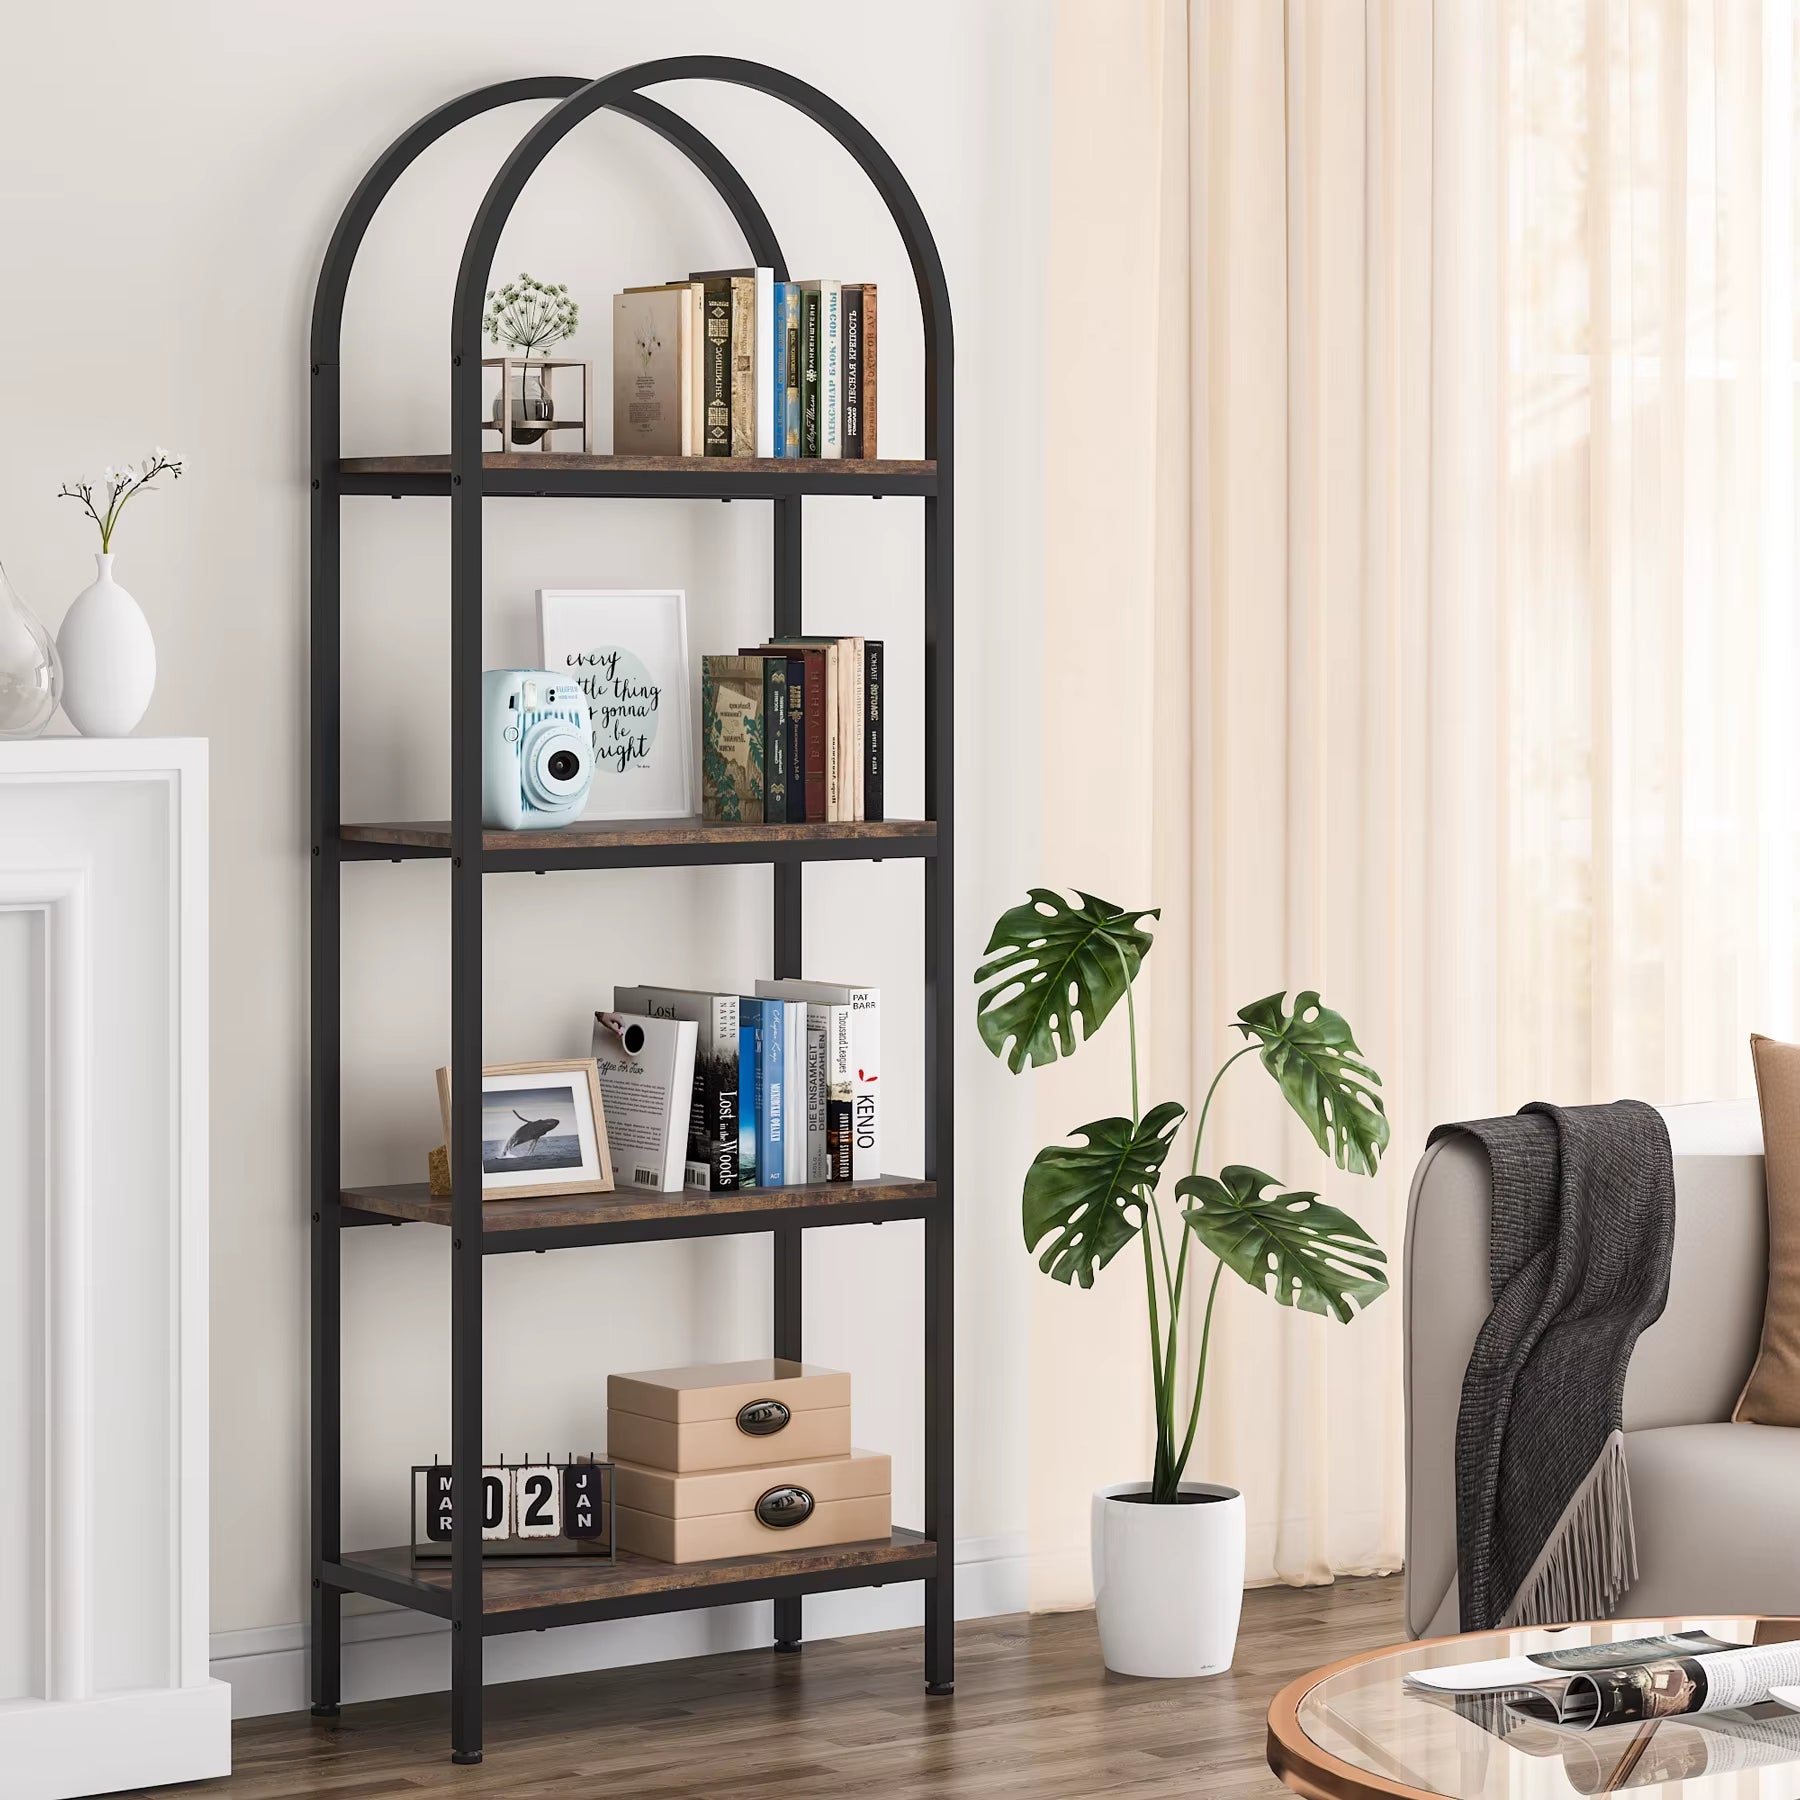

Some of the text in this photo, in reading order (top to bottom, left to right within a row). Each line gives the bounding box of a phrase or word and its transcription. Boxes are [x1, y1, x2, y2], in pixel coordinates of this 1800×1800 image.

[828, 292, 837, 445] АЛЕКСАНДР БЛОК ПОЭМЫ
[848, 310, 857, 404] ЛЕСНАЯ КРЕПОСТЬ
[567, 651, 621, 681] every
[612, 677, 661, 711] thing
[602, 705, 650, 728] gonna
[614, 719, 631, 740] be
[647, 999, 676, 1018] Lost
[853, 1002, 876, 1010] BARR
[837, 1012, 848, 1074] Thousand Leagues
[809, 1044, 817, 1131] DIE EINSAMKEIT
[719, 1091, 737, 1120] Lost
[857, 1095, 874, 1149] KENJO
[719, 1131, 729, 1141] the
[719, 1140, 737, 1185] Woods
[575, 1474, 592, 1528] JAN
